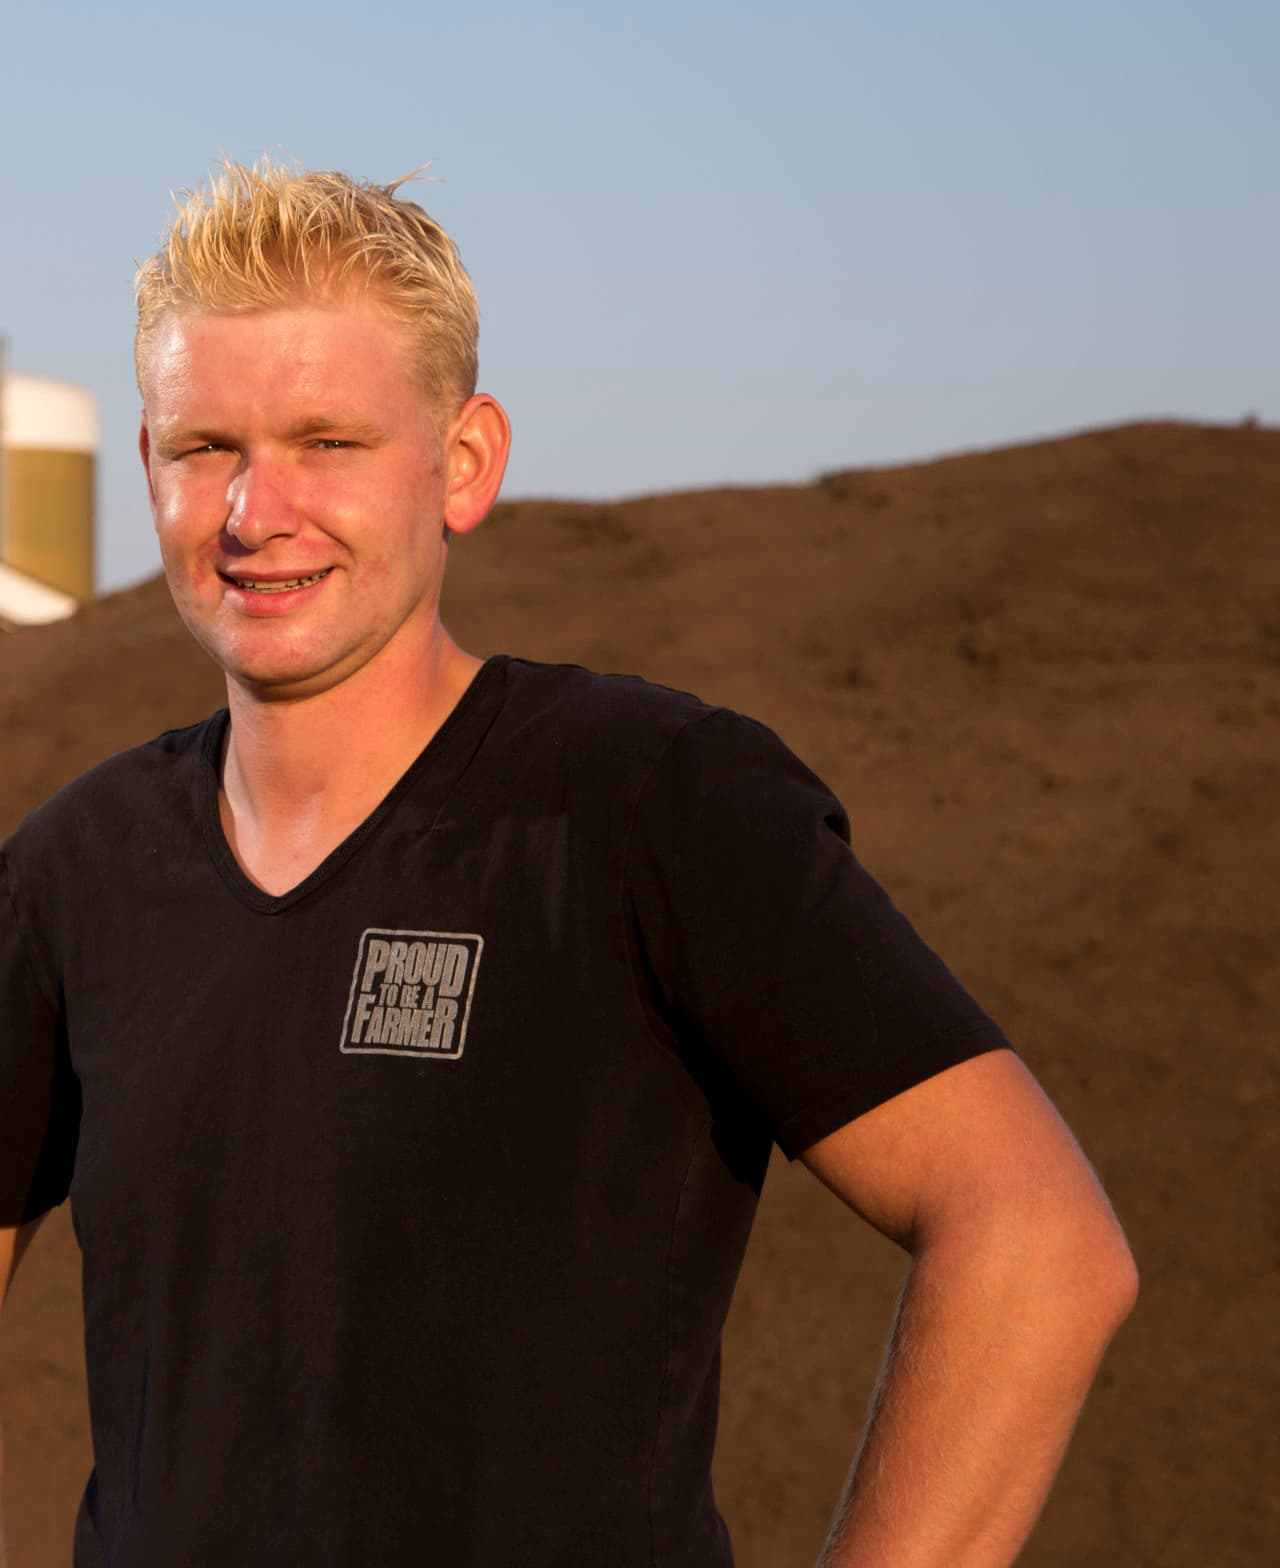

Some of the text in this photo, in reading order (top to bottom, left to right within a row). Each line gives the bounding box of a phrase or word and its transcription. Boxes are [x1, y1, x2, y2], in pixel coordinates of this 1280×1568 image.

[361, 940, 468, 997] PROUD
[378, 984, 434, 1009] TO BE A
[351, 993, 458, 1049] FARMER
